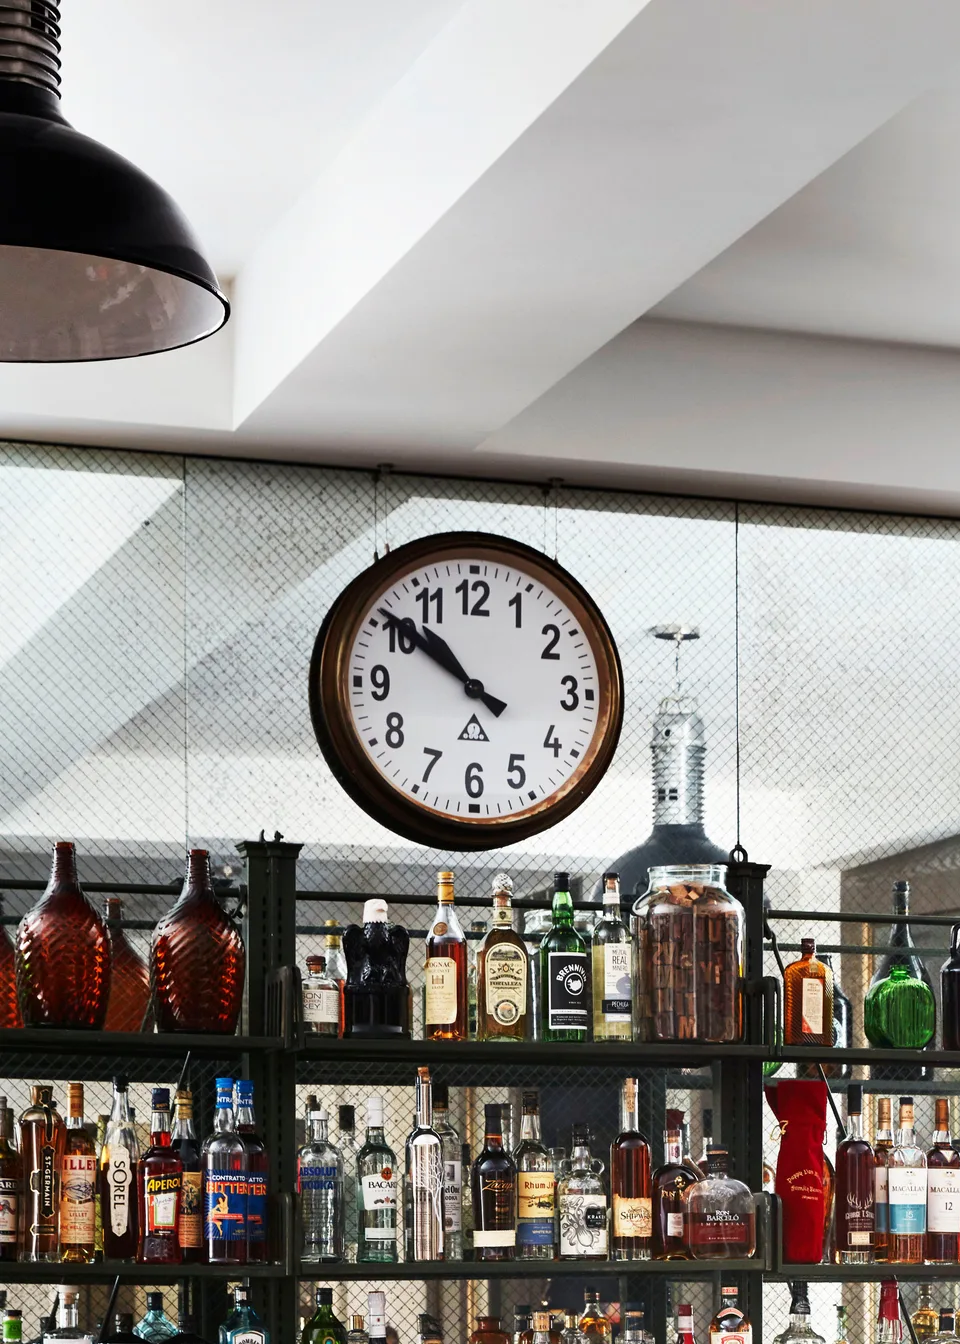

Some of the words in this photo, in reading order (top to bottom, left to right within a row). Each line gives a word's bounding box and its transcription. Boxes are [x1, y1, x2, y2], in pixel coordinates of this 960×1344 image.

[416, 587, 444, 624] 11
[455, 579, 490, 617] 12
[508, 592, 522, 628] 1
[382, 617, 416, 654] 10
[540, 624, 560, 660] 2
[370, 664, 390, 702] 9
[560, 675, 579, 711] 3
[385, 712, 404, 748] 8
[543, 725, 562, 758] 4
[422, 748, 442, 782] 7
[464, 762, 484, 798] 6
[506, 754, 526, 789] 5
[612, 956, 628, 965] REAL
[112, 1160, 128, 1209] SOREL
[299, 1166, 337, 1177] ABSOLUT
[302, 1181, 333, 1190] VODKA
[945, 1202, 952, 1210] 12
